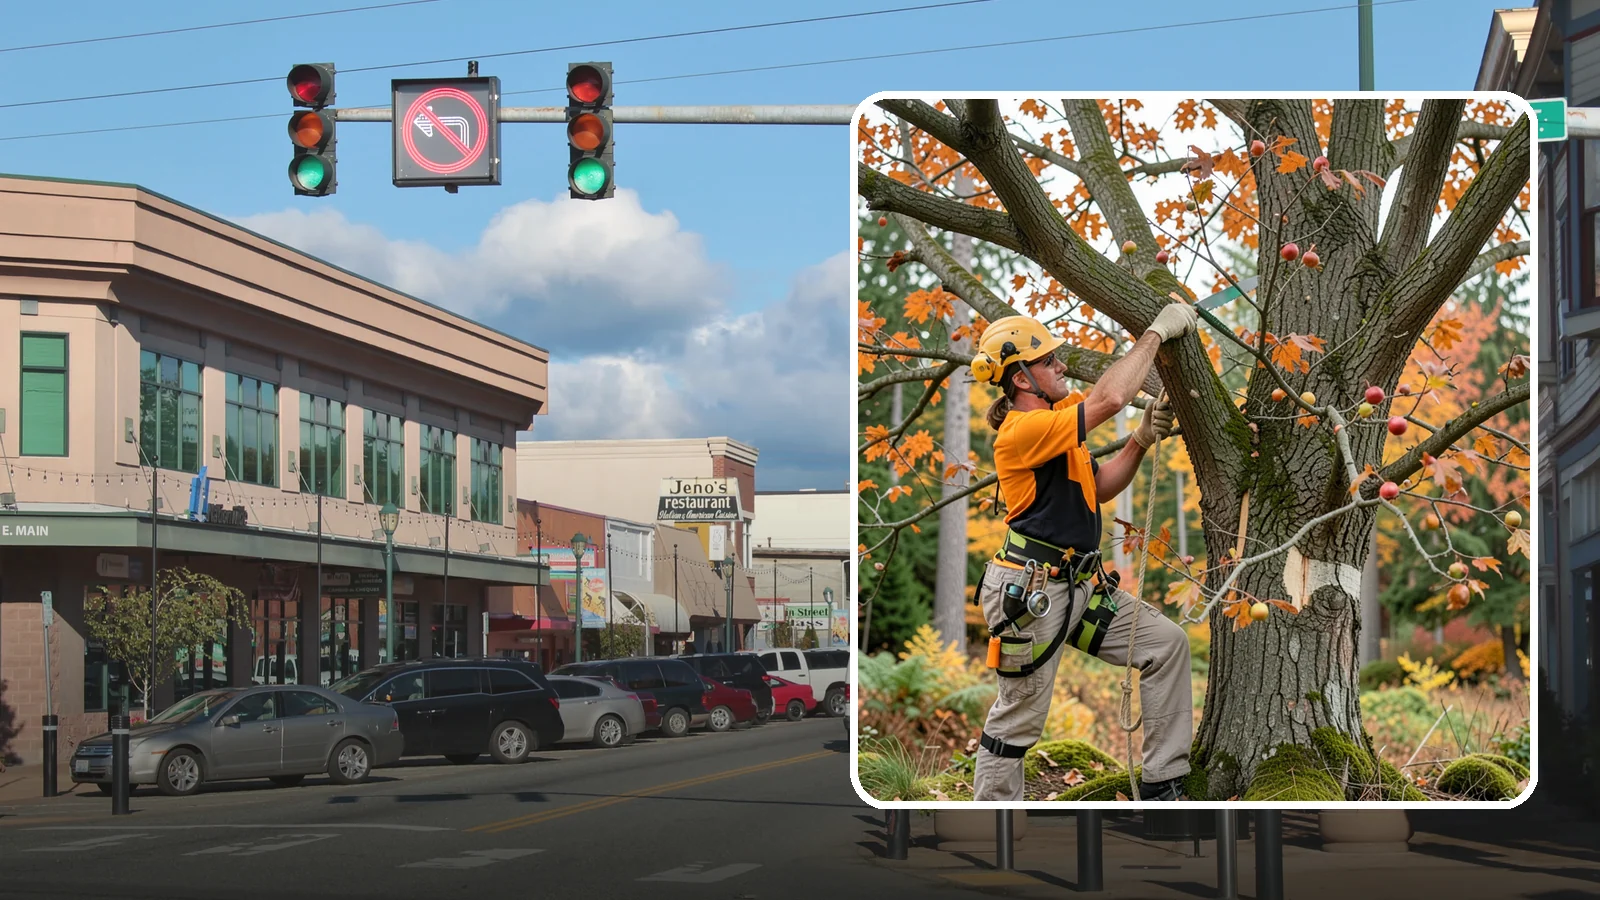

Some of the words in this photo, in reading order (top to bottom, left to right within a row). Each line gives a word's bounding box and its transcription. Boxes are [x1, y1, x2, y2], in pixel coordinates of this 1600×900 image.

[670, 480, 727, 494] Jeno's
[665, 496, 731, 509] restaurant
[686, 509, 715, 519] American
[715, 509, 738, 520] Cuisine
[2, 525, 13, 536] E.
[15, 525, 49, 536] MAIN
[797, 607, 829, 617] Street
